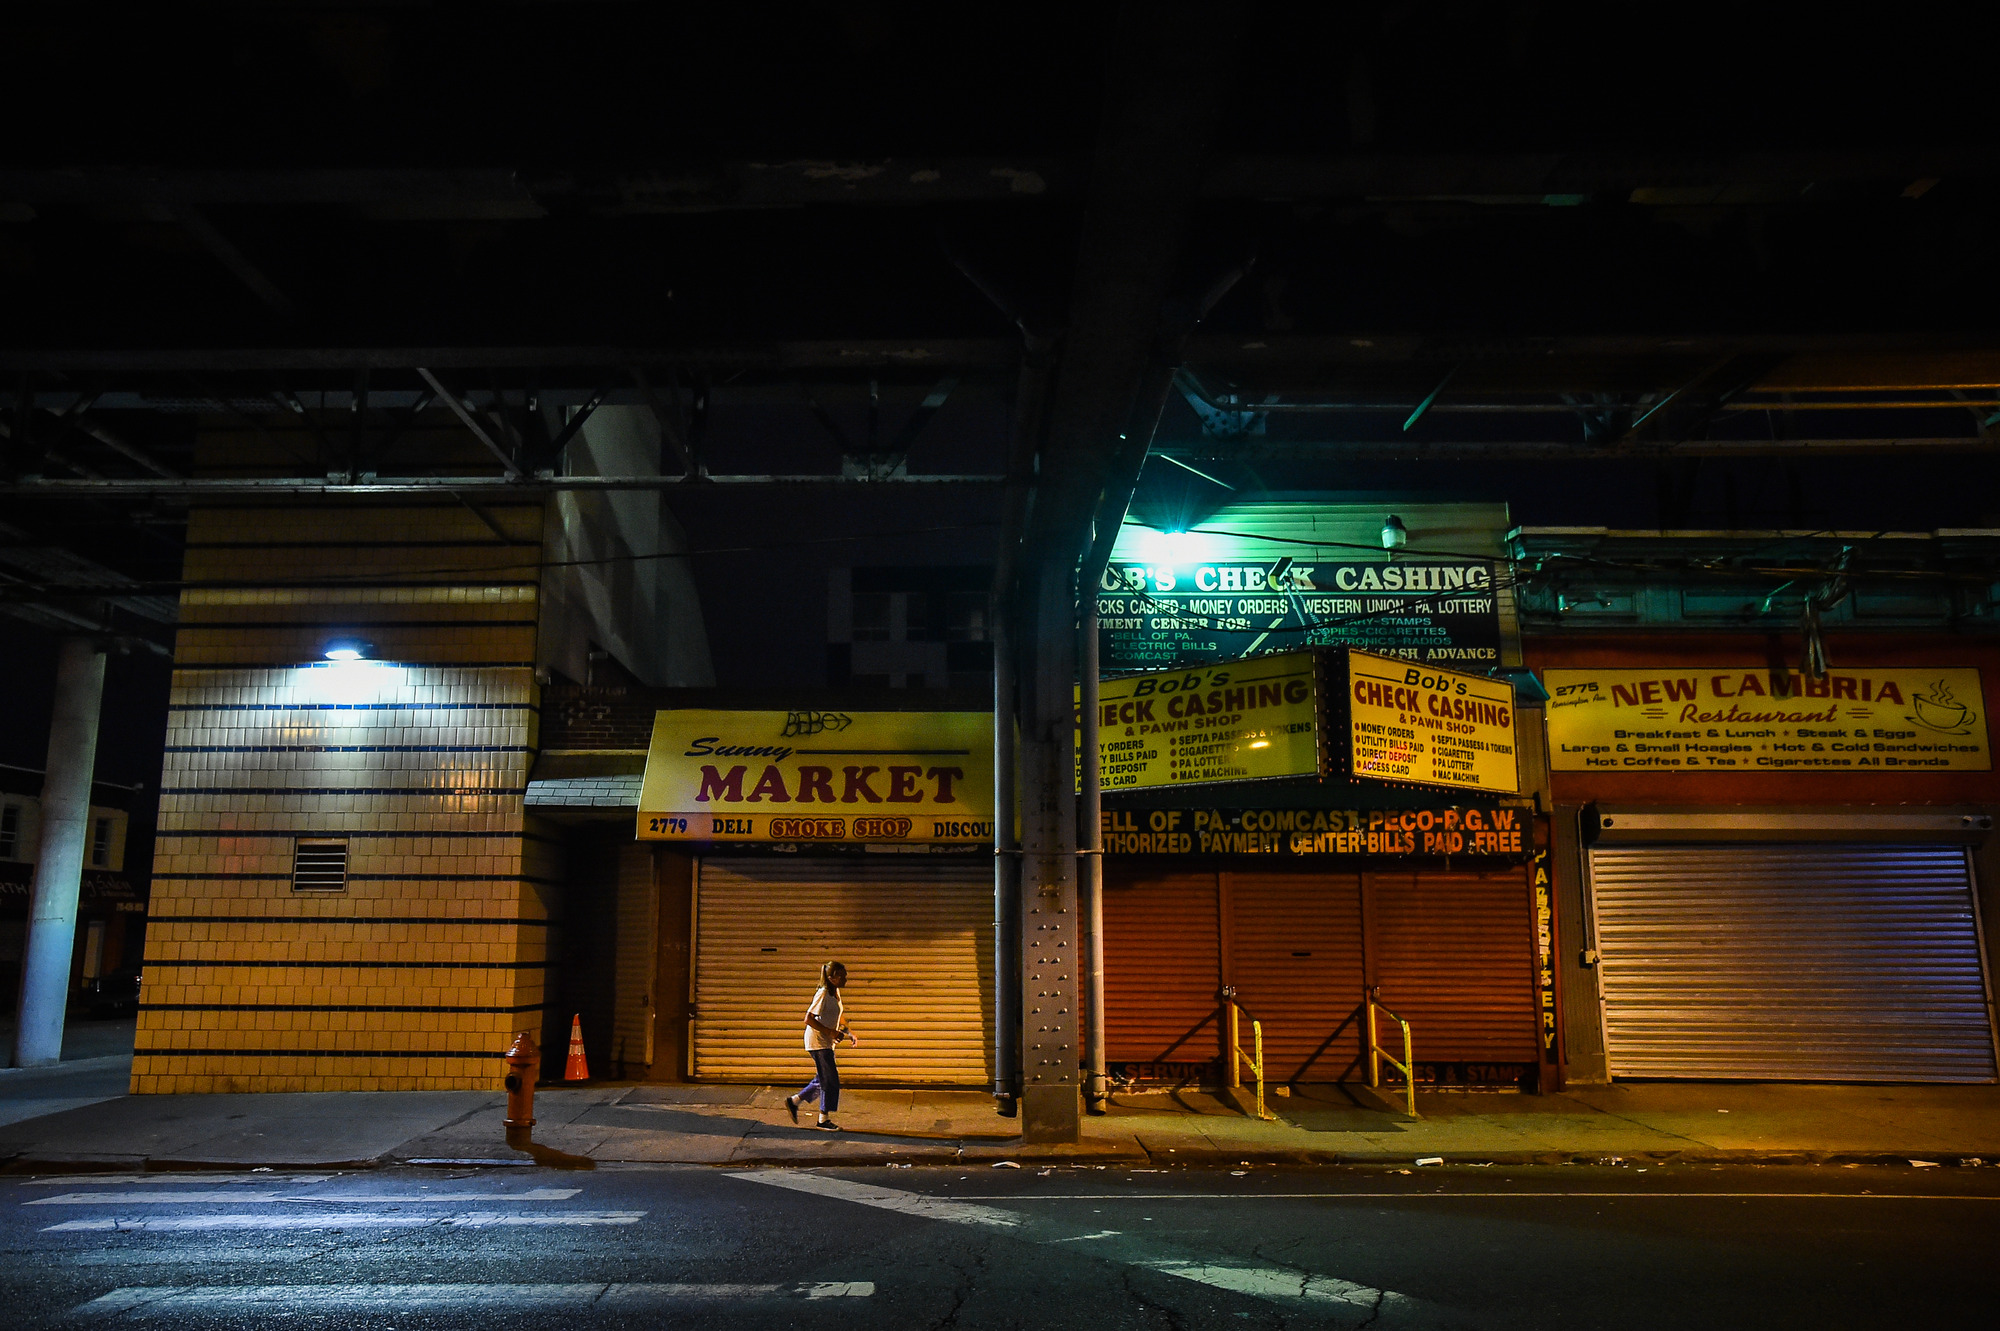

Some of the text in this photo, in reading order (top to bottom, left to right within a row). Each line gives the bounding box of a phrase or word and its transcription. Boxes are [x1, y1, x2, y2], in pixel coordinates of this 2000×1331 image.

[1101, 566, 1491, 592] OB'S CHECK CASHING
[1129, 599, 1180, 615] CASHED
[1189, 599, 1235, 615] MONEY
[1237, 599, 1289, 615] ORDERS
[1303, 598, 1492, 614] WESTERN UNION PA. LOTTERY
[1150, 617, 1209, 630] CENTER
[1216, 617, 1252, 630] FOR:
[1114, 632, 1194, 641] BELL OF PA.
[1114, 642, 1217, 650] ELECTRIC BILLS
[1426, 648, 1496, 660] ADVANCE
[1114, 651, 1179, 660] COMCAST
[1133, 670, 1231, 698] Bob's
[1404, 668, 1468, 696] Bob's
[1555, 681, 1600, 697] 2775
[1610, 673, 1905, 708] NEW CAMBRIA
[1167, 679, 1309, 719] CASHING
[1353, 680, 1511, 729] CHECK CASHING
[1679, 703, 1838, 724] Restaurant
[1124, 714, 1243, 737] & PAWN SHOP
[1360, 723, 1415, 740] MONEY ORDERS
[1398, 713, 1476, 735] & PAWN SHOP
[1178, 733, 1210, 745] SEPTA
[1437, 735, 1457, 747] SEPTA
[1614, 728, 1917, 739] Breakfast & Lunch Steak & Eggs
[683, 737, 794, 763] Sunny
[1107, 740, 1144, 751] ORDERS
[1361, 736, 1425, 753] UTILITY BILLS PAID
[1561, 743, 1980, 754] Large & Small Hoagies Hot & Cold Sandwiches
[1109, 752, 1134, 763] BILLS
[1136, 750, 1158, 761] PAID
[1361, 748, 1418, 764] DIRECT DEPOSIT
[1437, 747, 1475, 760] CIGARETTES
[1109, 762, 1148, 775] DEPOSIT
[1179, 759, 1192, 769] PA
[1362, 760, 1410, 775] ACCESS CARD
[1437, 758, 1474, 771] PA LOTTERY
[1586, 757, 1950, 767] Hot Coffee & Tea Cigarettes All Brands
[1113, 775, 1137, 786] CARD
[1179, 767, 1248, 781] MAC MACHINE
[1437, 769, 1480, 783] MAC MACHINE
[694, 764, 964, 803] MARKET
[649, 818, 688, 834] 2779
[711, 818, 753, 834] DELI
[770, 818, 845, 838] SMOKE
[853, 818, 912, 839] SHOP
[1100, 811, 1139, 832] ELL
[1149, 811, 1182, 832] OF
[1101, 833, 1192, 854] THORIZED
[1200, 833, 1281, 854] PAYMENT
[1423, 831, 1464, 853] PAID
[1474, 831, 1523, 853] FREE
[1124, 1063, 1217, 1080] SERVICE
